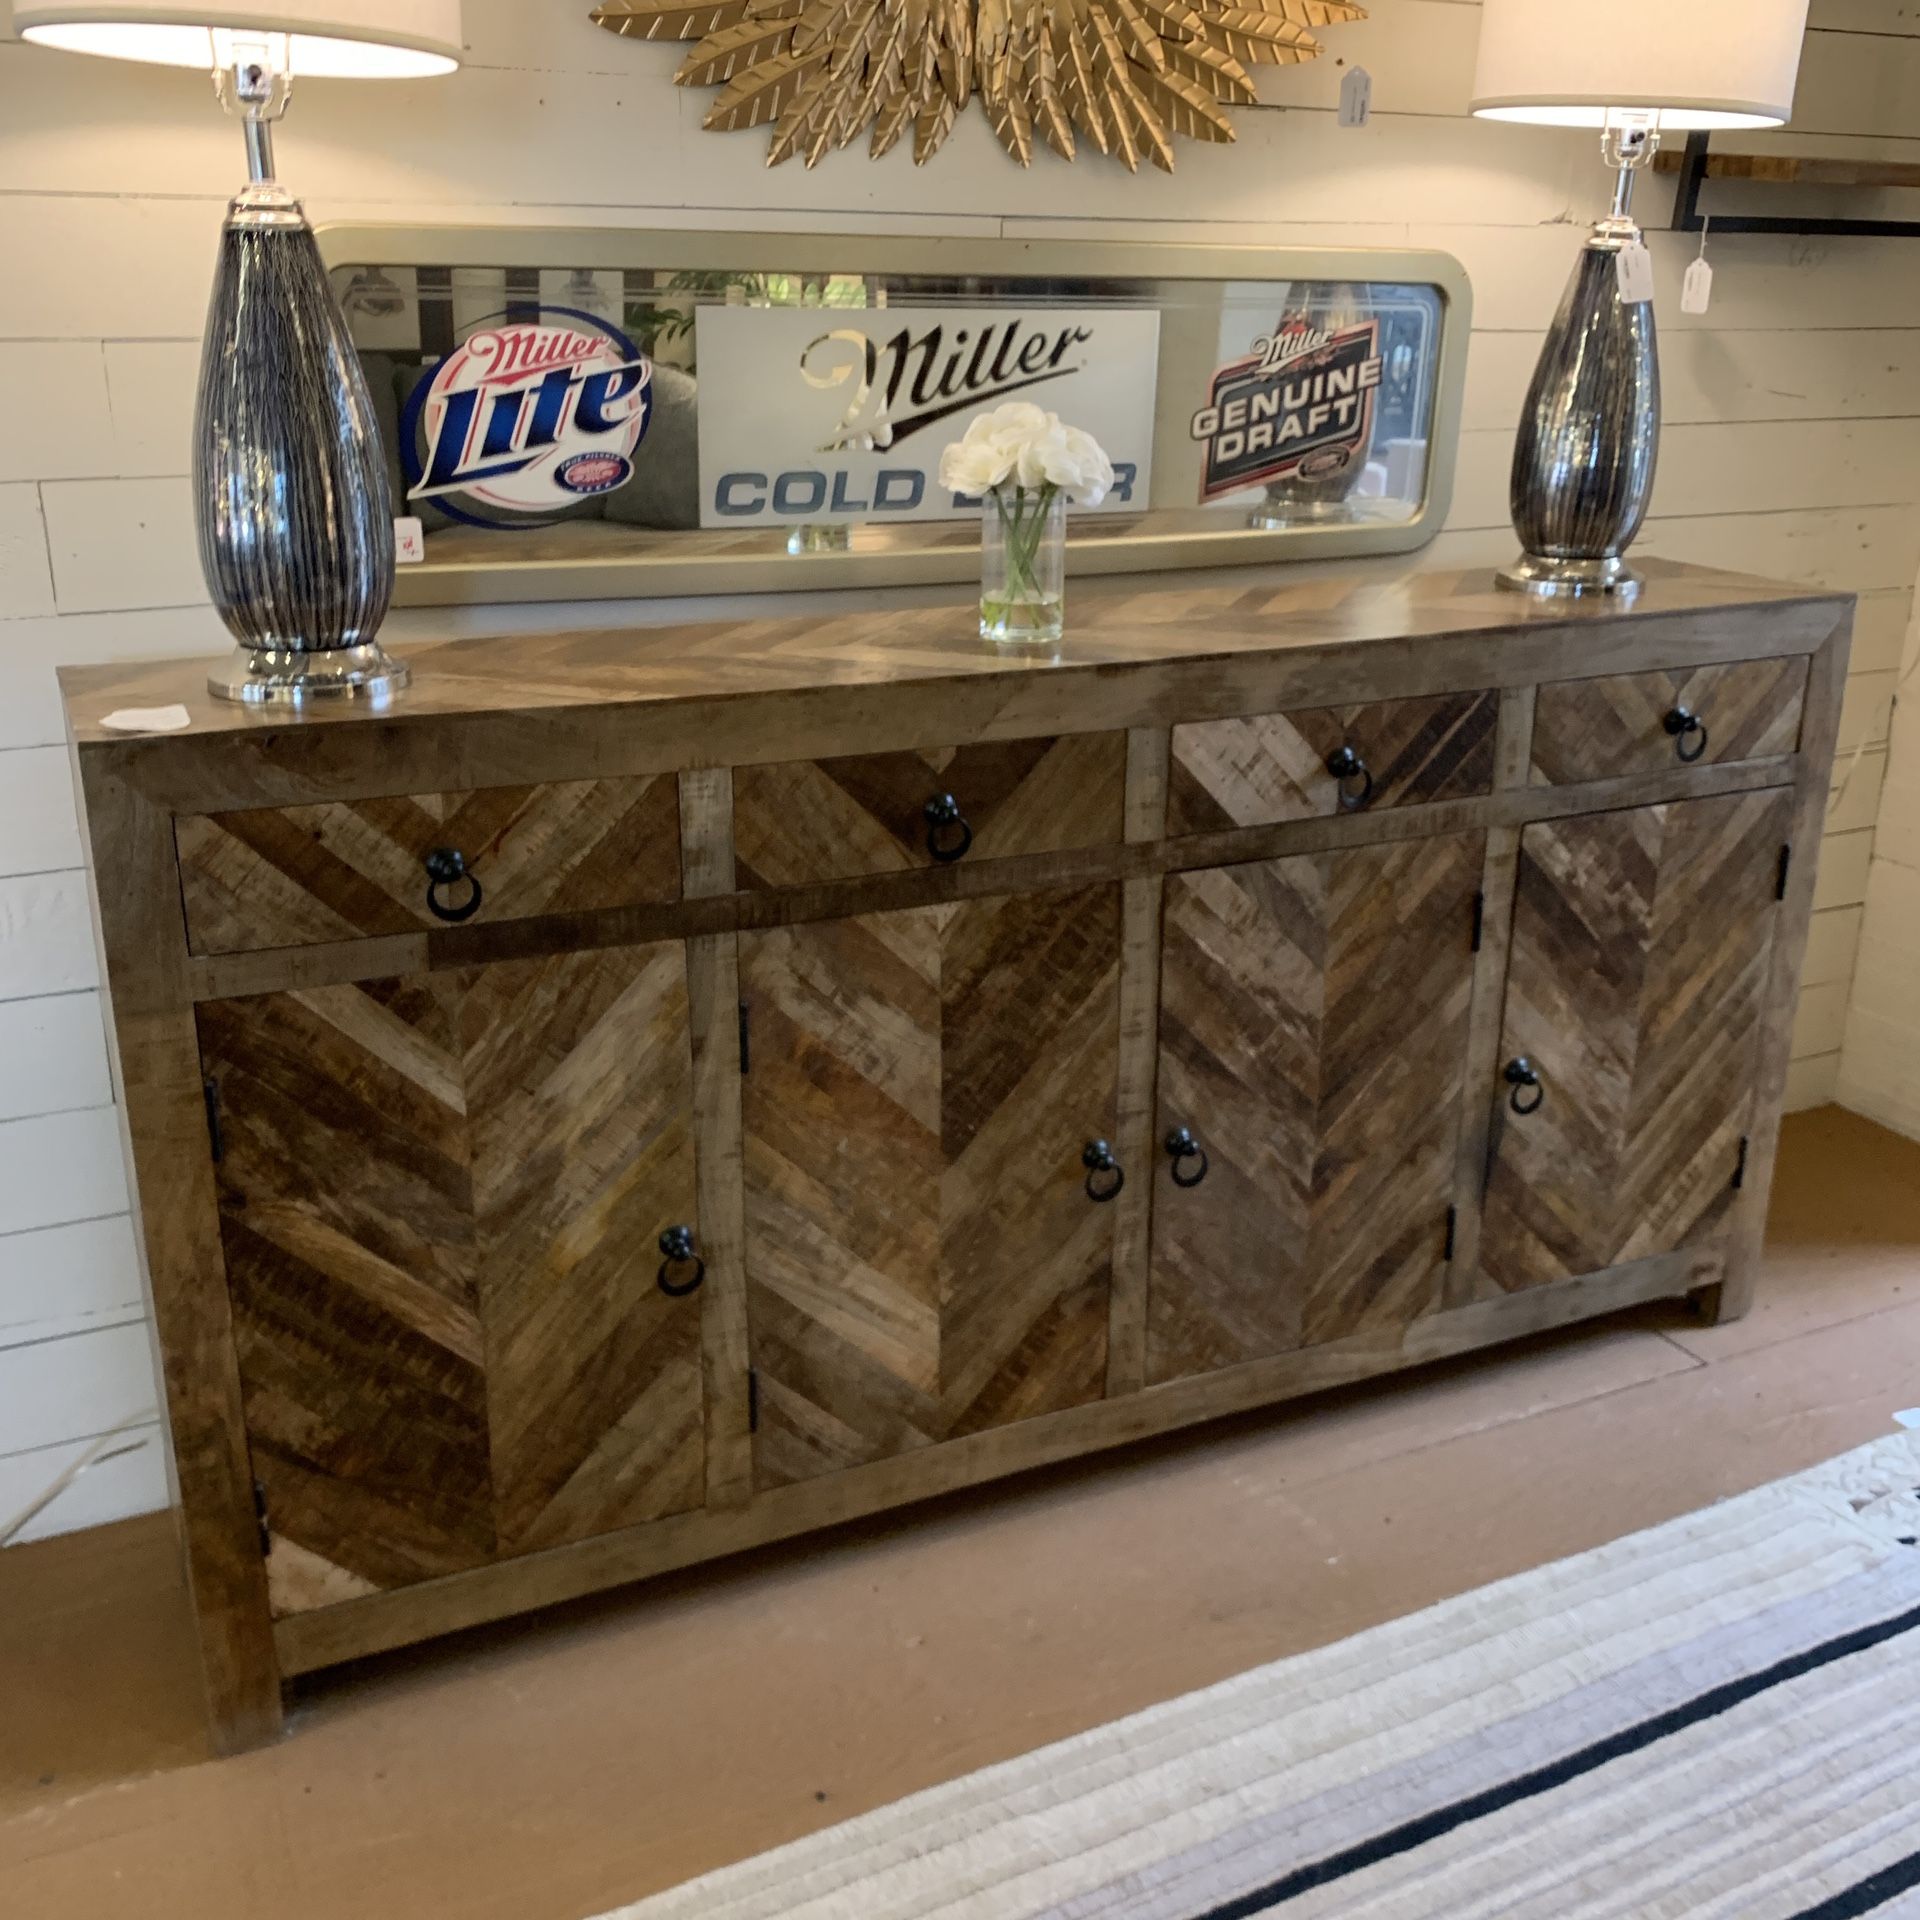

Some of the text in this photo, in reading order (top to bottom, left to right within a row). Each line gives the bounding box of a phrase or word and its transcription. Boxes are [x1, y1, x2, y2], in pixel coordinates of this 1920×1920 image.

[468, 331, 609, 385] Miller
[800, 318, 1093, 453] Miller
[1252, 328, 1335, 376] Miller
[412, 361, 651, 498] Lite
[1191, 356, 1383, 438] GENUINE
[1215, 396, 1357, 463] DRAFT
[714, 469, 926, 516] COLD
